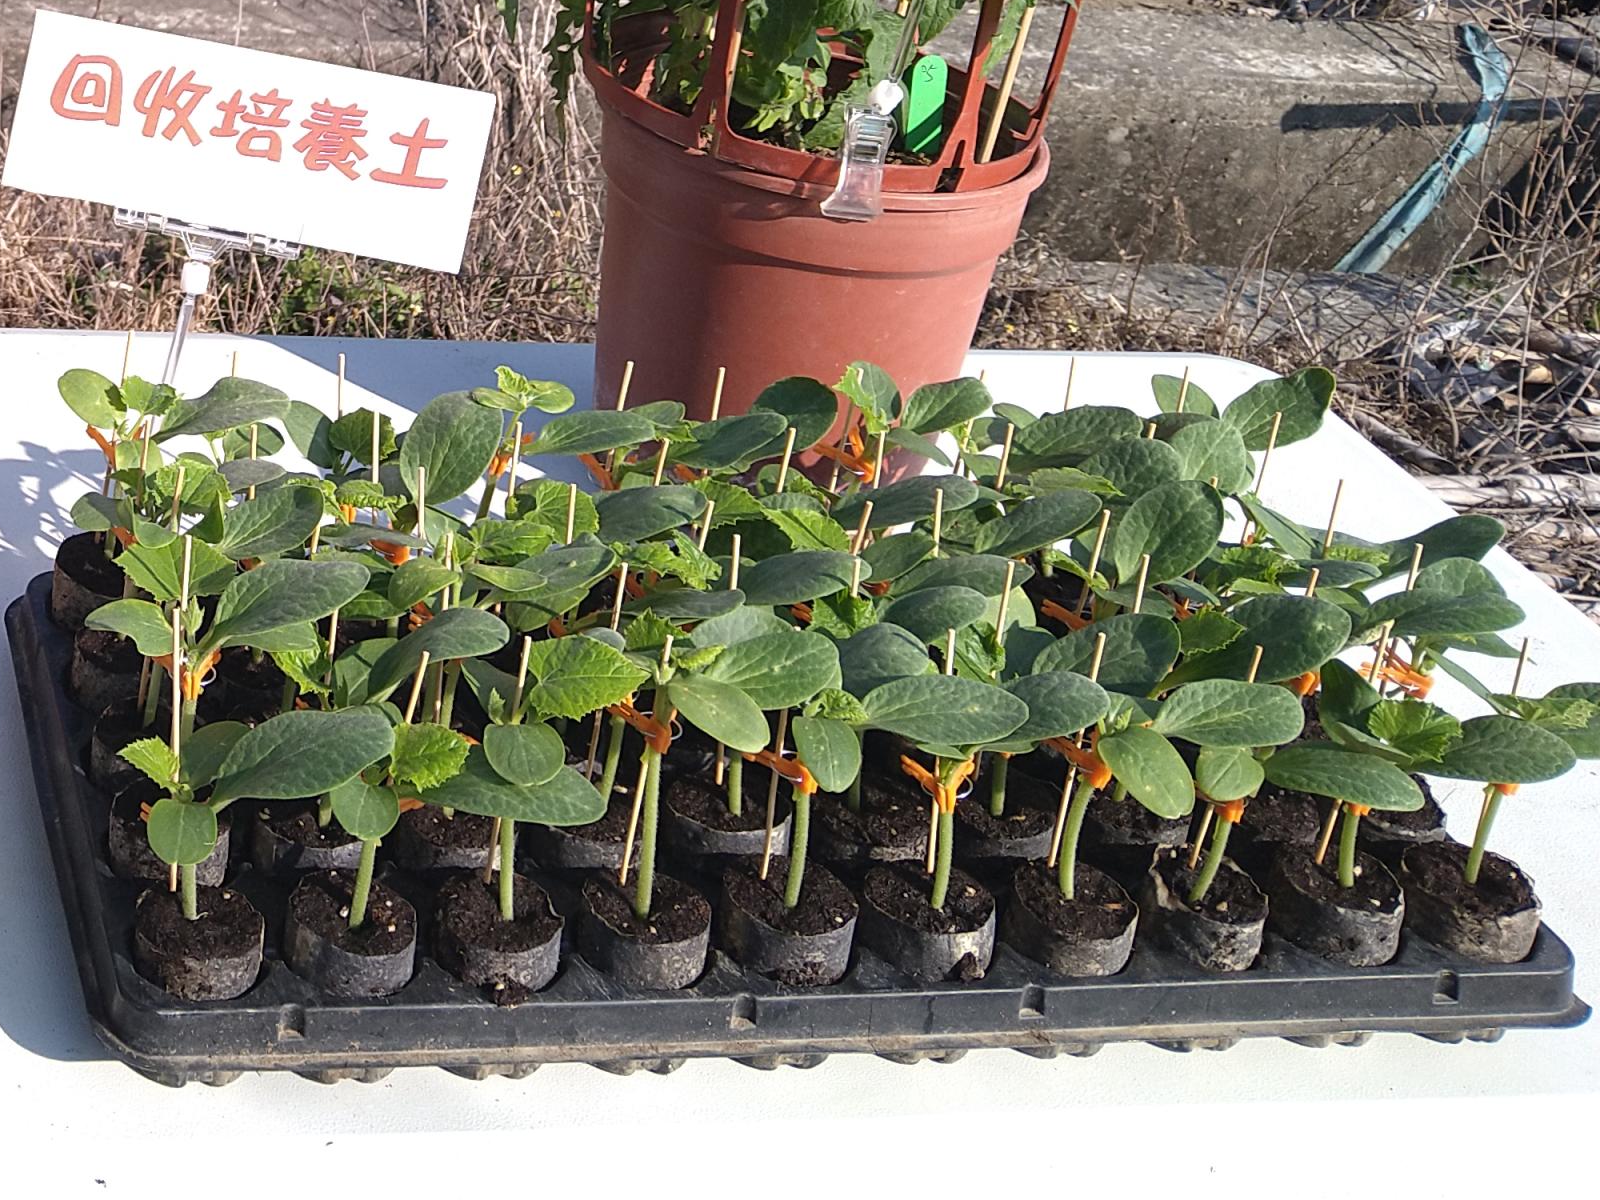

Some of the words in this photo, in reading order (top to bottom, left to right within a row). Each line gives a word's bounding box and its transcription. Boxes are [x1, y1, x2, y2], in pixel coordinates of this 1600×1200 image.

[50, 53, 449, 189] 回收培養土
